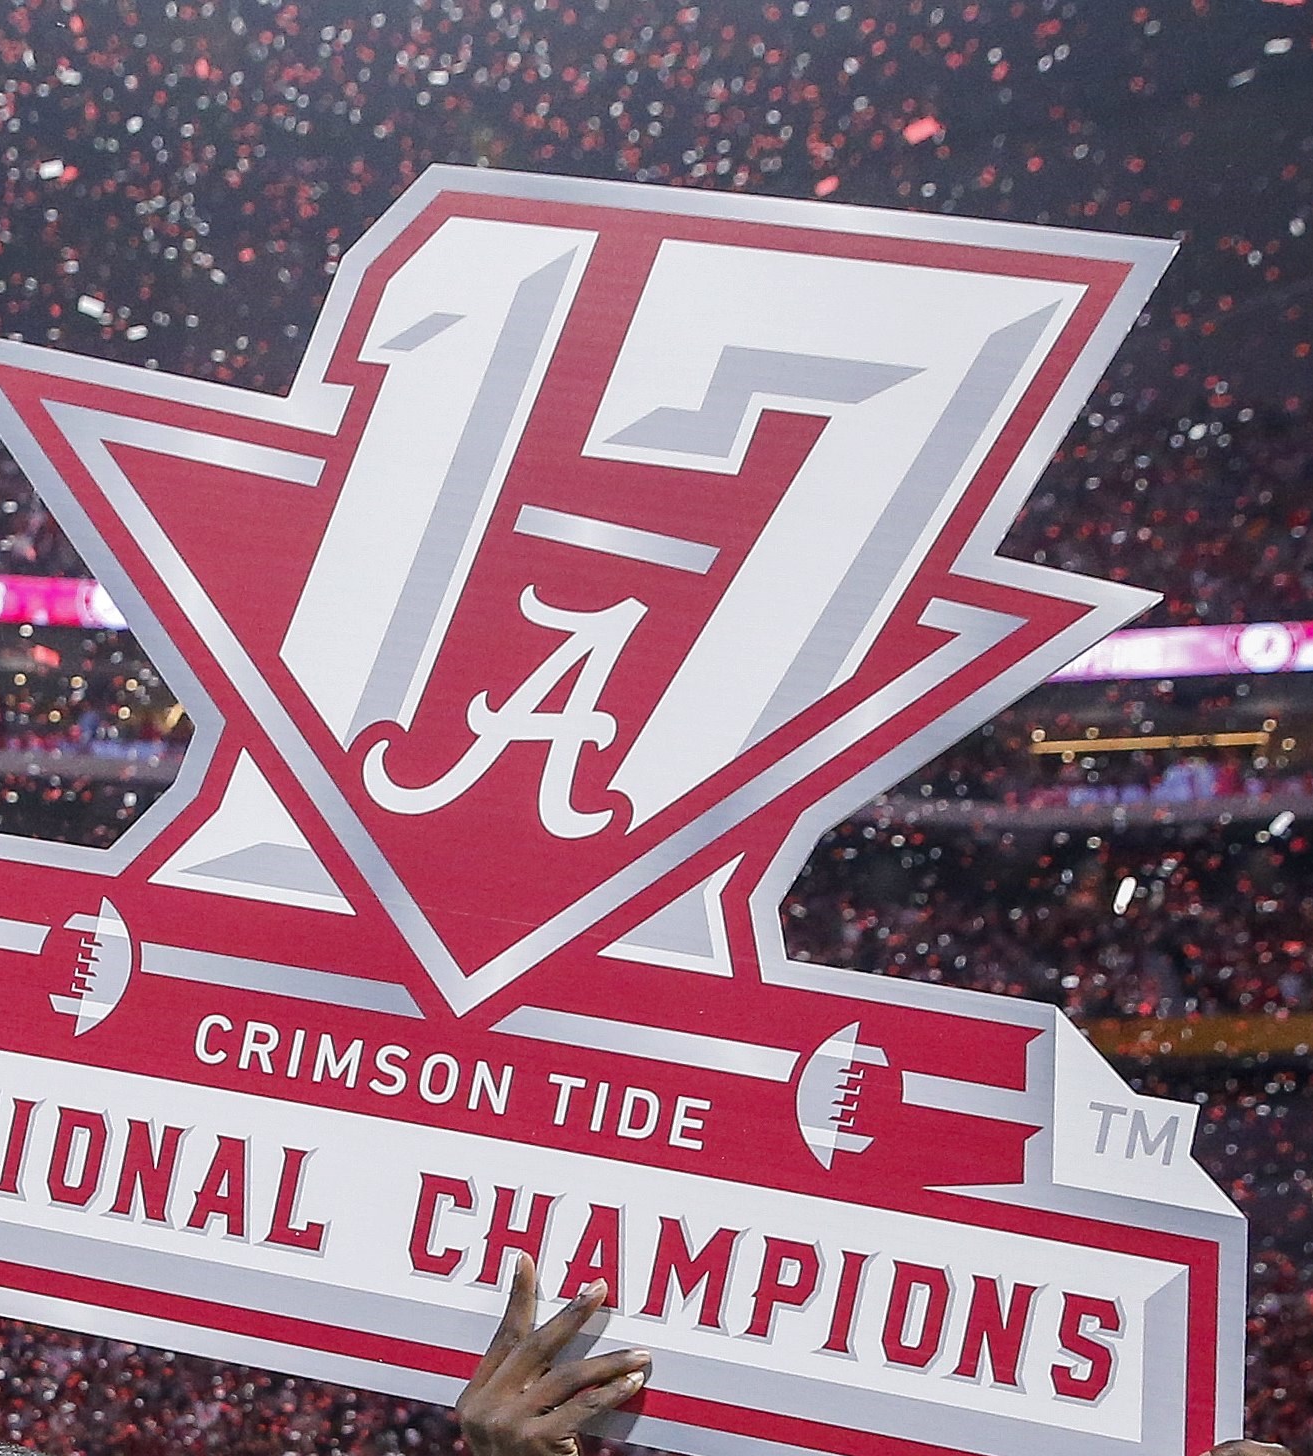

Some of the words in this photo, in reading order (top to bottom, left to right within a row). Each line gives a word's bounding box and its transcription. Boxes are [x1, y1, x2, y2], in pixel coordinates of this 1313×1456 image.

[279, 216, 1089, 834] 17
[193, 1013, 515, 1115] CRIMSON
[546, 1071, 713, 1151] TIDE
[1089, 1101, 1180, 1166] TM
[404, 1169, 1129, 1408] CHAMPIONS
